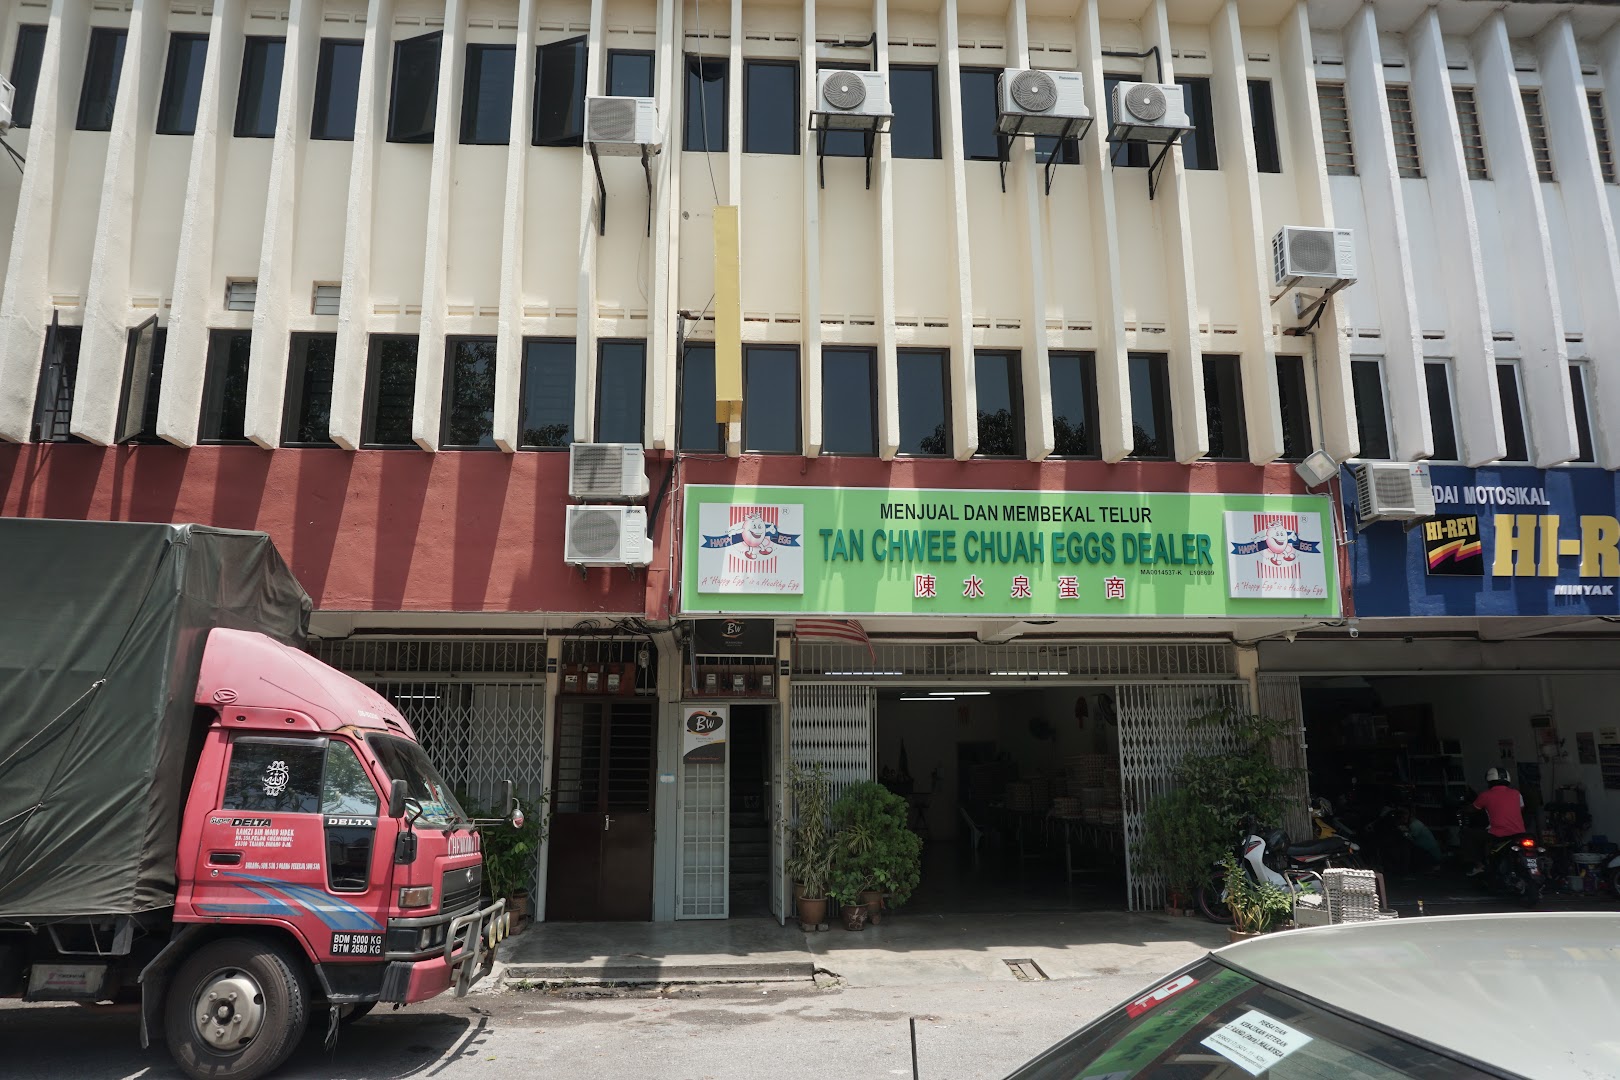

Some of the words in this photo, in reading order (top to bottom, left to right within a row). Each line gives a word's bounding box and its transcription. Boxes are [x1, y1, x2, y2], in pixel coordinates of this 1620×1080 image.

[1432, 485, 1458, 504] DAI
[1463, 485, 1550, 506] MOTOSIKAL
[880, 503, 959, 520] MENJUAL
[964, 504, 998, 522] DAN
[1002, 505, 1096, 523] MEMBEKAL
[1099, 506, 1152, 524] TELUR
[1426, 517, 1477, 541] HI-REV
[710, 537, 732, 548] HAPPY
[778, 536, 792, 544] EGG
[819, 528, 864, 562] TAN
[872, 528, 957, 563] CHWEE
[964, 530, 1044, 564] CHUAH
[1052, 532, 1115, 566] EGGS
[1123, 533, 1214, 566] DEALER
[1238, 544, 1259, 554] HAPPY
[1300, 543, 1312, 552] EGG
[788, 580, 800, 590] Egg
[1313, 585, 1324, 595] Egg
[1554, 584, 1614, 596] MINYAK
[230, 818, 272, 827] DELTA
[334, 934, 351, 944] BDM
[352, 935, 368, 944] 5000
[370, 935, 382, 945] KG
[333, 944, 349, 953] BTM
[351, 944, 368, 953] 2680
[369, 945, 381, 954] KG
[1264, 1032, 1288, 1048] VETERAN
[1258, 1040, 1285, 1058] MALAYSIA
